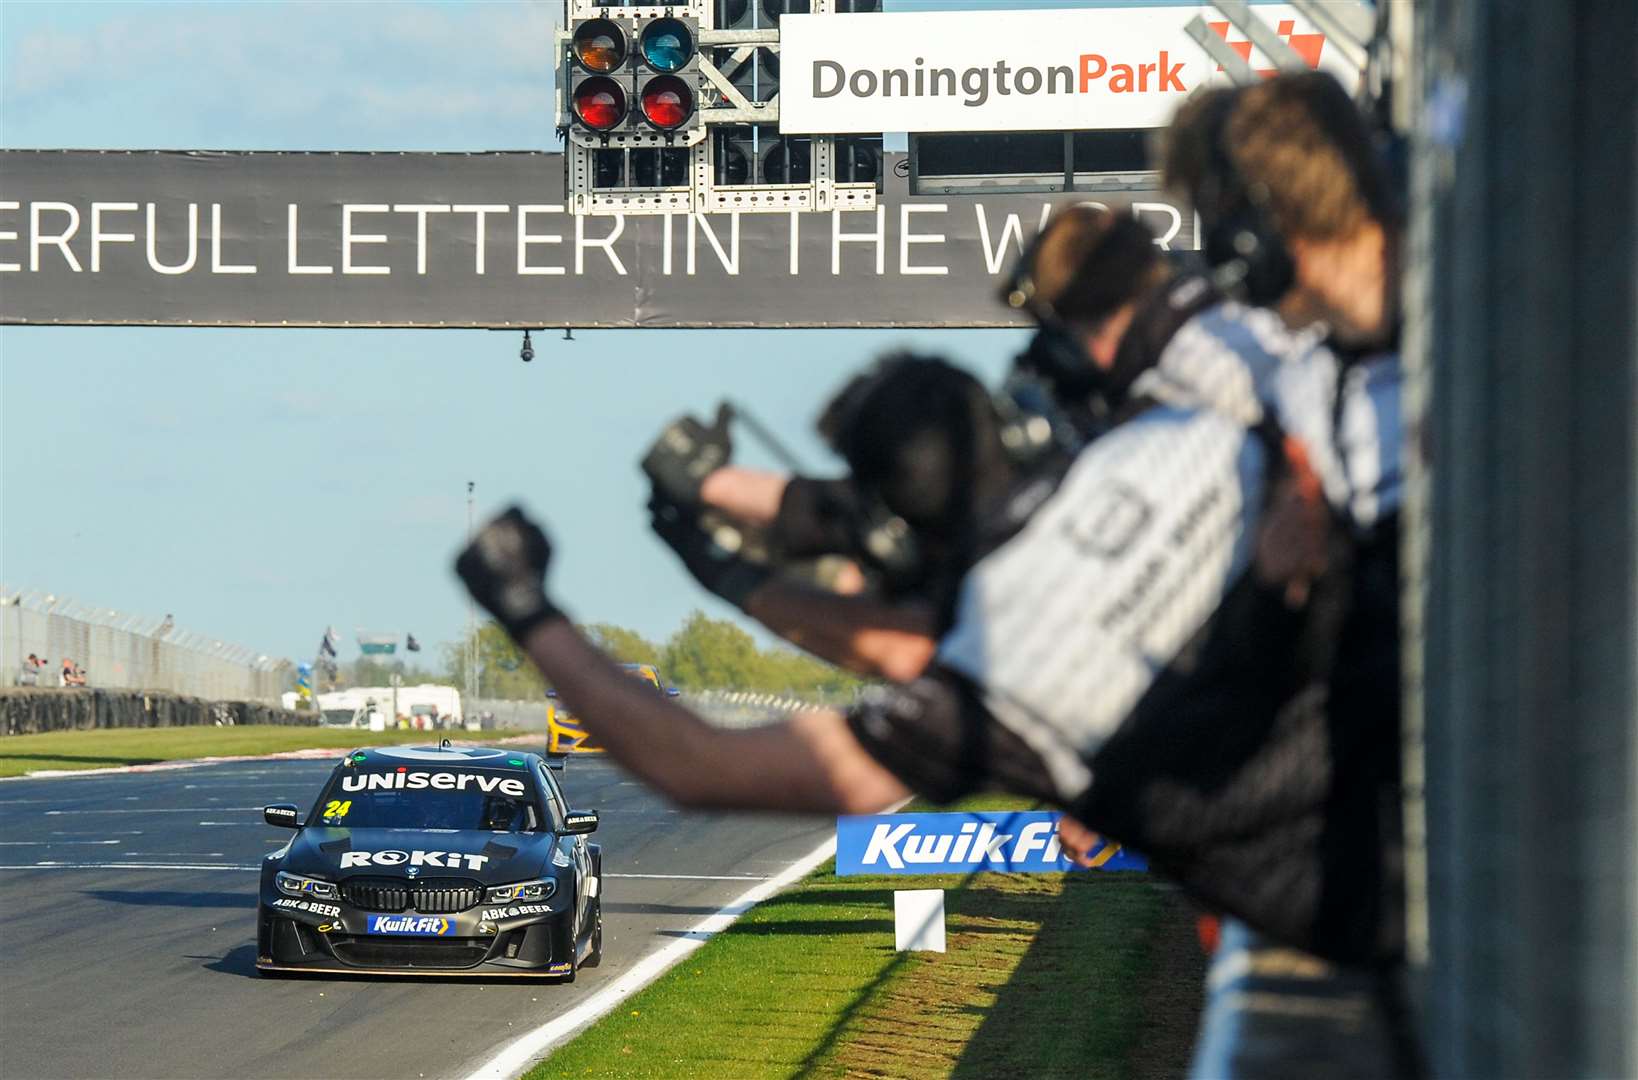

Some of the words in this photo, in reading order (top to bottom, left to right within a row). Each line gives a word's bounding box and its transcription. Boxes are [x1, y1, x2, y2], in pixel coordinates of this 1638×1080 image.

[288, 203, 628, 275] LETTER
[663, 212, 740, 275] IN
[323, 800, 352, 817] 24
[272, 899, 300, 908] ABK
[308, 902, 341, 918] BEER
[481, 907, 509, 921] ABK
[518, 905, 552, 915] BEER
